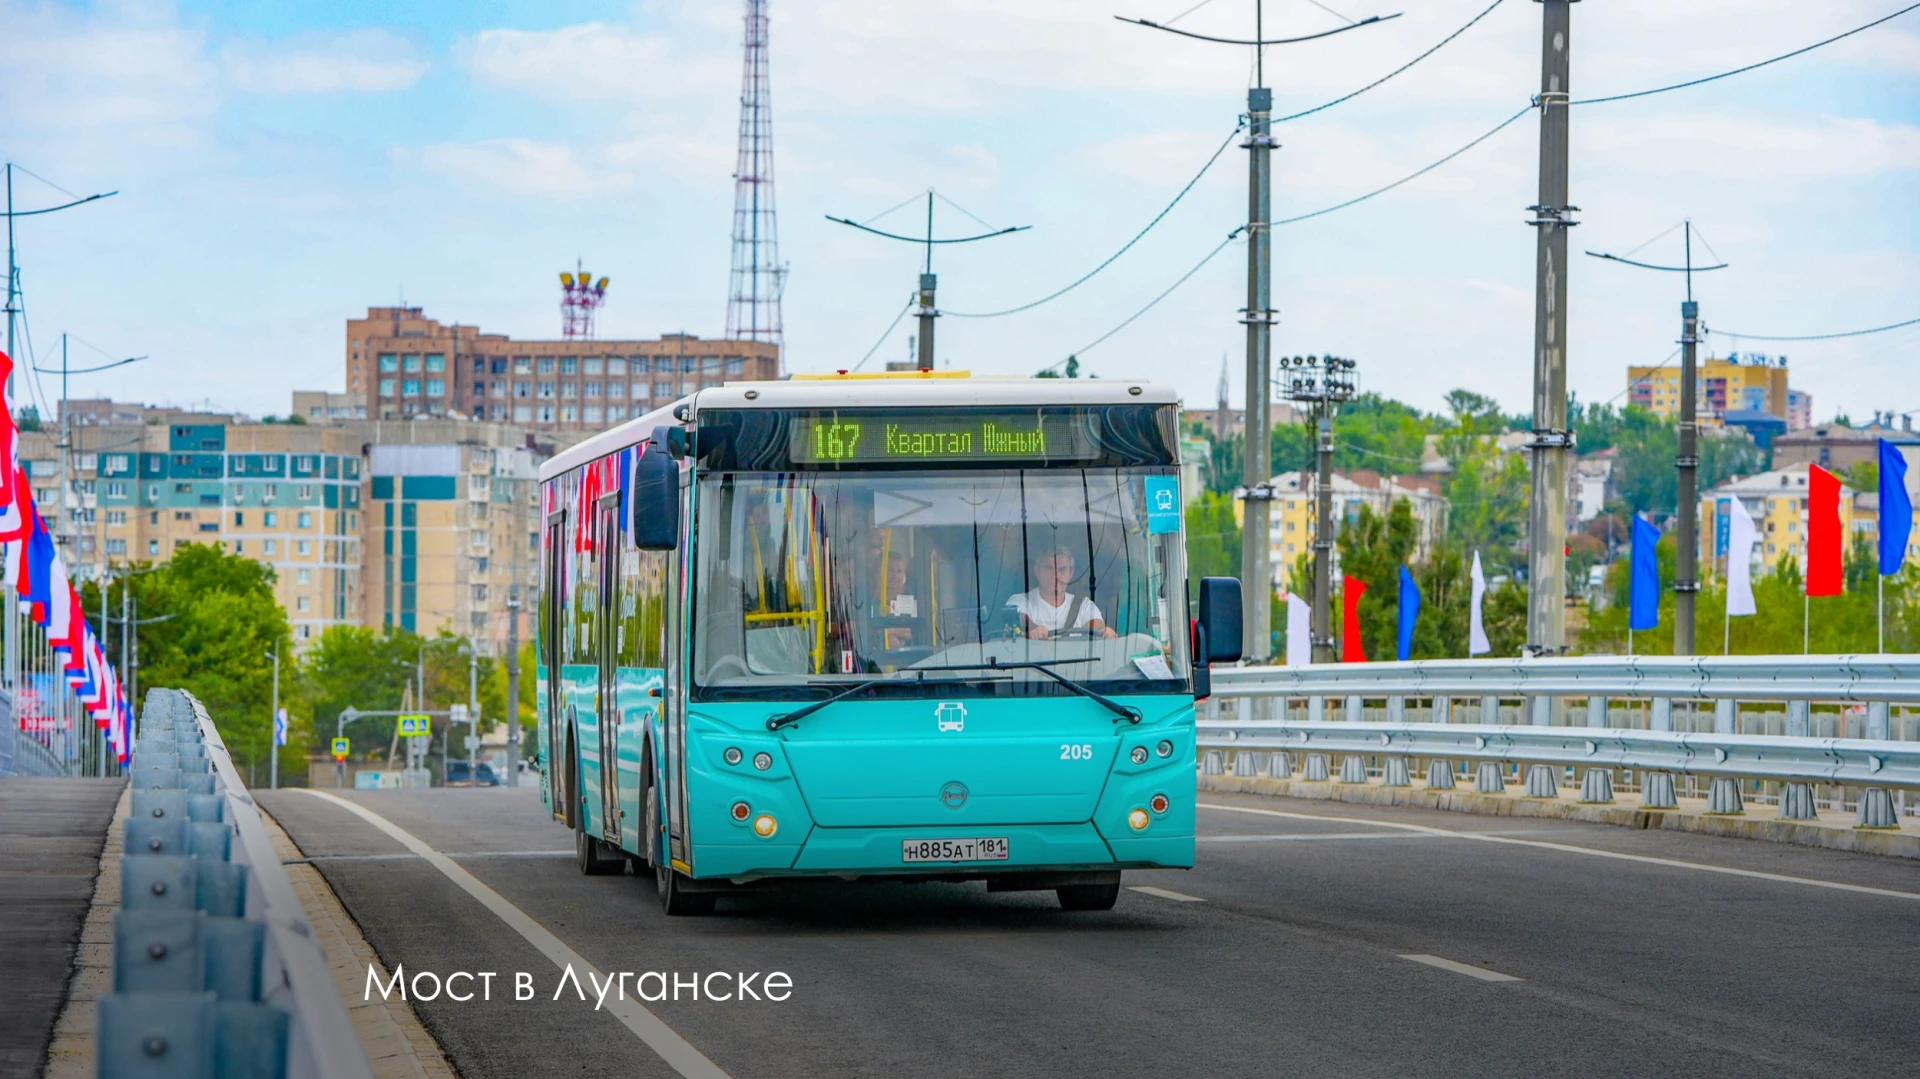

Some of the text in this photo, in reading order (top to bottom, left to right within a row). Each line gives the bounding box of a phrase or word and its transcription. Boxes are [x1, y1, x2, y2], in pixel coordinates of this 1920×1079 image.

[815, 423, 1045, 458] 167 Квартал Южный
[1060, 744, 1093, 760] 205
[908, 839, 1003, 859] Н885АТ 181
